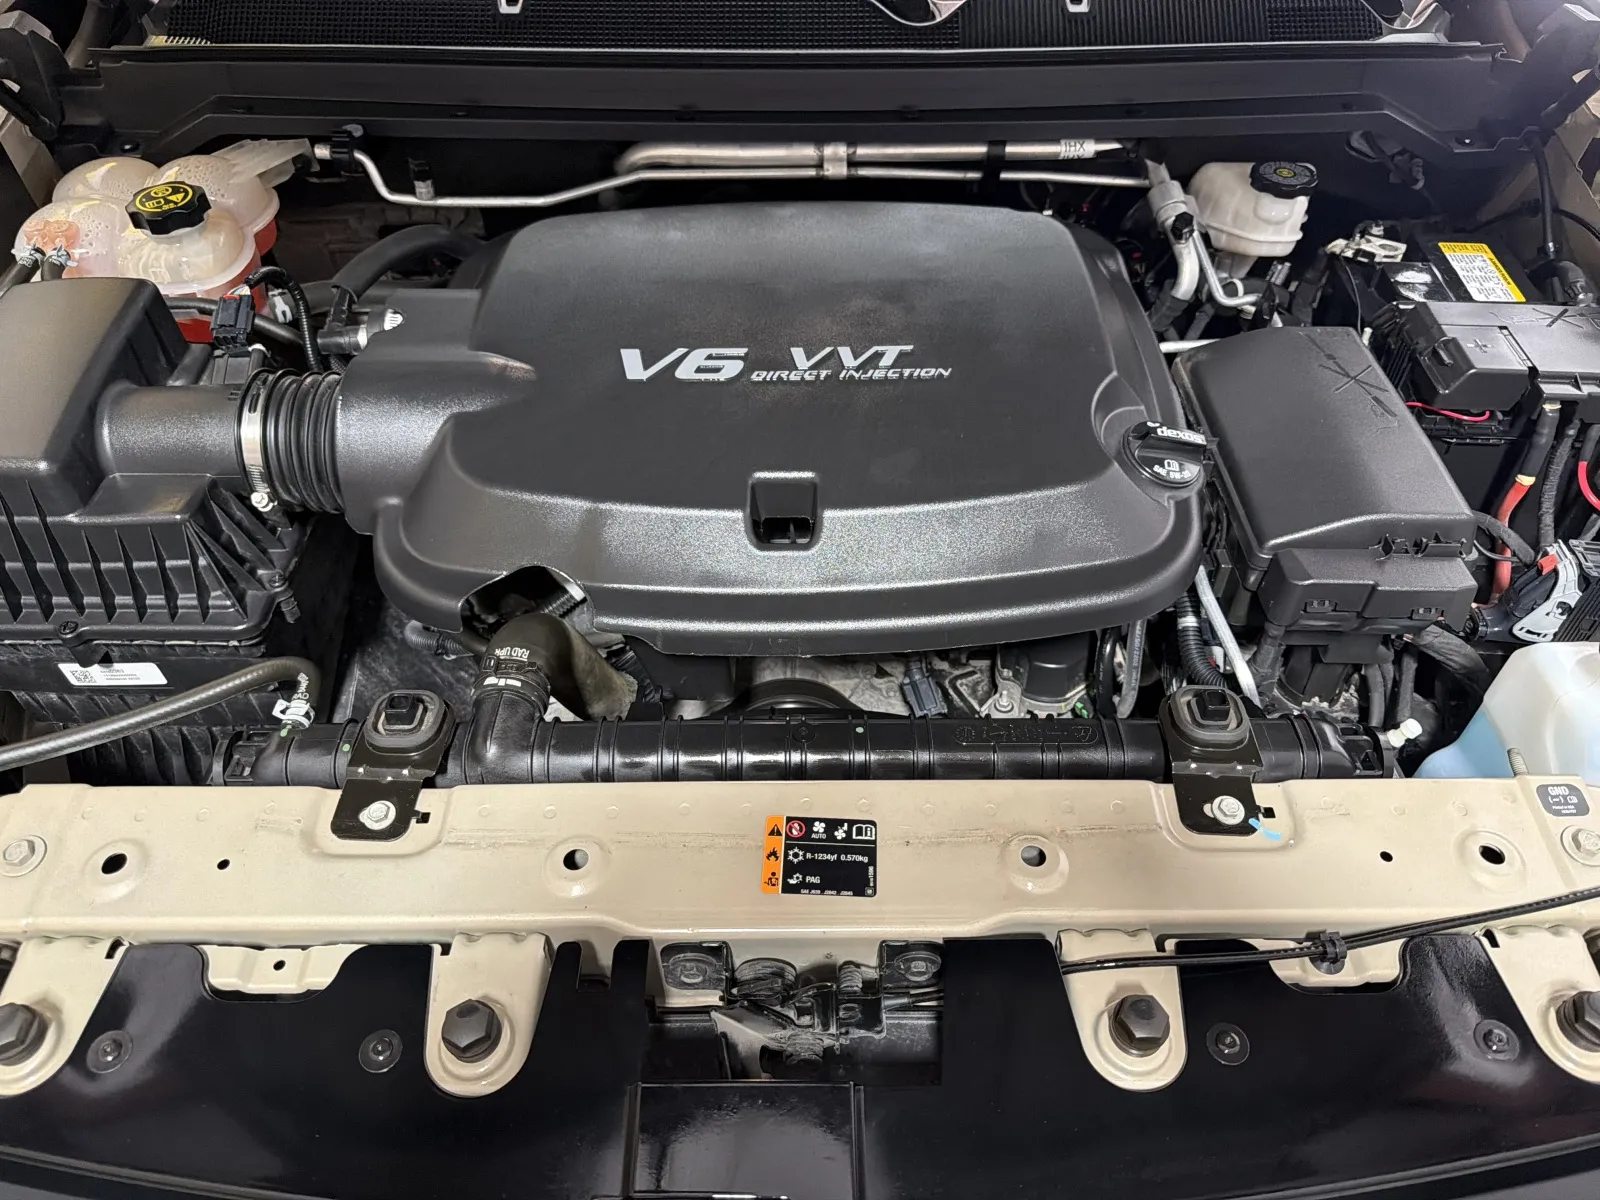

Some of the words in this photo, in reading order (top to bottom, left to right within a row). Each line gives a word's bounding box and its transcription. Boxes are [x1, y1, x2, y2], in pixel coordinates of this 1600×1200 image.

[790, 344, 914, 369] VVT
[620, 347, 749, 382] V6
[750, 369, 832, 382] DIRECT
[838, 367, 952, 381] INJECTION
[1153, 464, 1168, 476] SAE
[511, 647, 530, 659] RAD
[1547, 785, 1570, 796] GND
[806, 852, 838, 861] R-1234yf
[840, 854, 869, 863] 0.570kg
[806, 875, 821, 884] PAG
